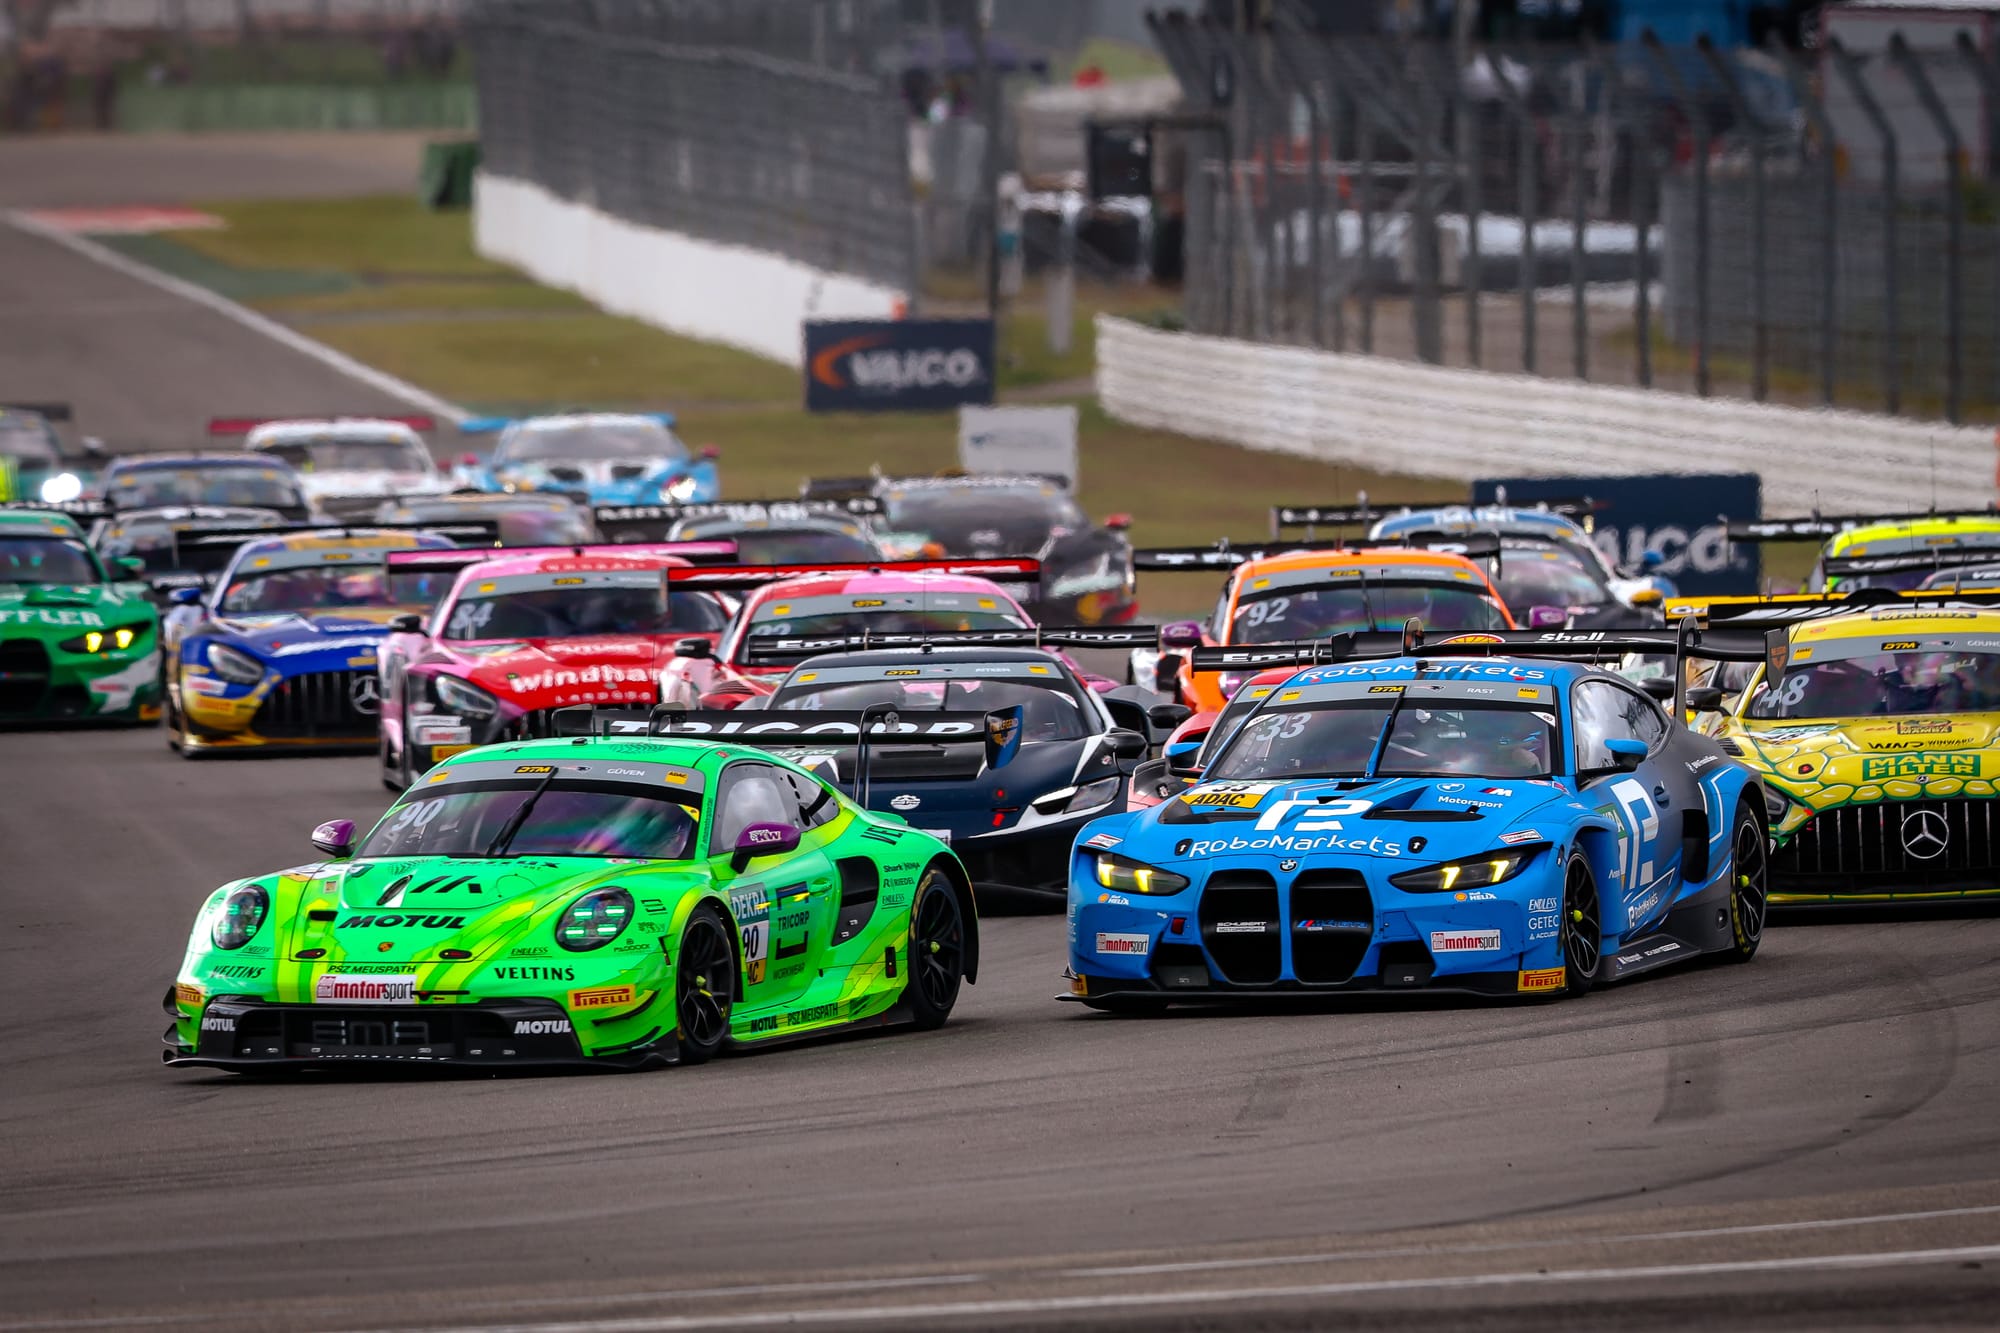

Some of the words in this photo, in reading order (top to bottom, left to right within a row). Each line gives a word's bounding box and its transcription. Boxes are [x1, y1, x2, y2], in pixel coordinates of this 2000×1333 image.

[453, 602, 495, 629] 84
[1249, 599, 1290, 627] 92
[1538, 632, 1605, 641] Shell
[1883, 642, 1916, 650] DTM
[510, 664, 663, 693] windha
[1300, 663, 1545, 682] RoboMarkets
[1760, 674, 1809, 707] 48
[1256, 712, 1312, 741] 33
[1869, 755, 1975, 769] MANN
[517, 766, 551, 774] DTM
[607, 767, 645, 776] GÜVEN
[1869, 764, 1975, 778] FILTER
[1190, 794, 1245, 806] ADAC
[1437, 795, 1504, 809] Motorsport
[392, 799, 446, 831] 90
[1189, 834, 1401, 858] RoboMarkets
[732, 888, 769, 921] DEKRA
[1469, 893, 1498, 901] HELIX
[1528, 897, 1558, 911] ENDLESS
[337, 914, 466, 930] MOTUL
[777, 911, 810, 932] TRICORP
[1528, 915, 1560, 930] GETEC
[510, 946, 549, 956] ENDLESS
[1106, 939, 1148, 953] motorsport
[1445, 935, 1500, 951] motorsport
[328, 965, 350, 973] PSZ
[351, 965, 417, 974] MEUSPATH
[494, 966, 575, 981] VELTINS
[1523, 970, 1563, 987] PIRELLI
[334, 981, 414, 1002] motorsport
[574, 988, 630, 1007] PIRELLI
[201, 1018, 236, 1032] MOTUL
[514, 1019, 571, 1035] MOTUL
[751, 1015, 778, 1033] MOTUL
